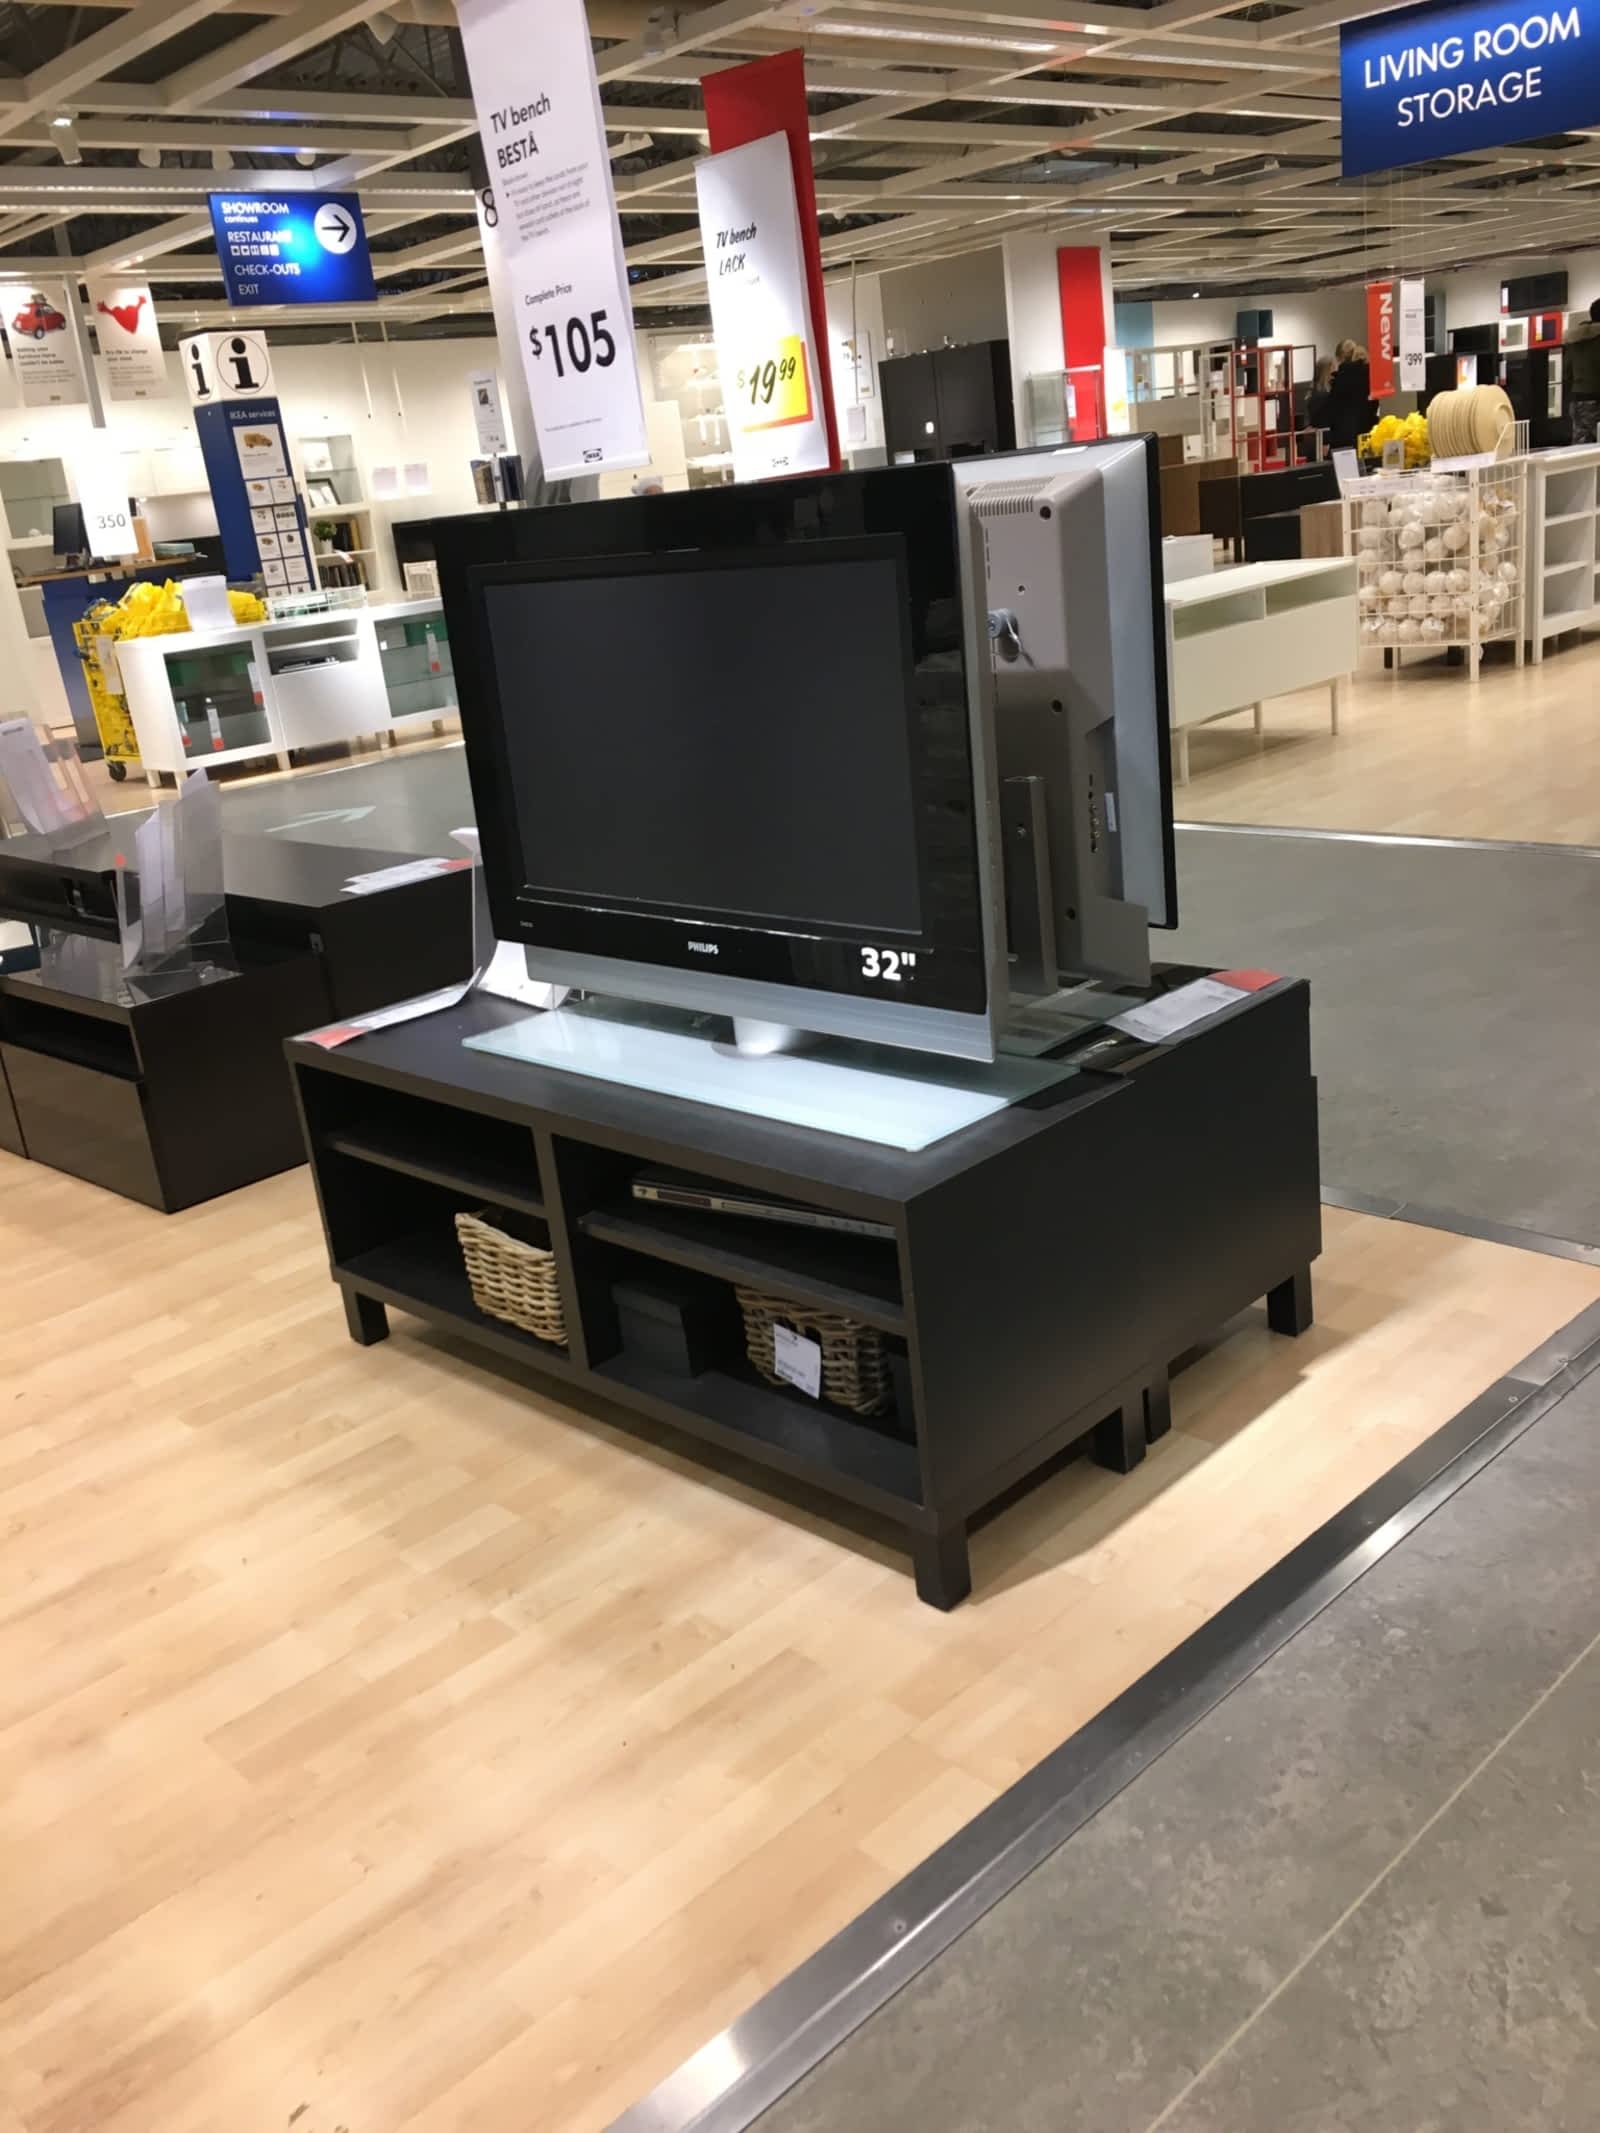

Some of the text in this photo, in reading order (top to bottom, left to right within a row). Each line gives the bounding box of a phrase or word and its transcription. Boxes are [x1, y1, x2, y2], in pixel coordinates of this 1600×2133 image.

[1364, 7, 1581, 89] LIVING ROOM
[1397, 66, 1542, 127] STORAGE
[490, 92, 551, 133] TV bench
[221, 201, 290, 215] SHOWROOM
[227, 230, 293, 243] RESTAURA
[716, 222, 757, 249] TV bench
[234, 263, 301, 276] CHECK-OUTS
[719, 253, 746, 276] LACK
[238, 283, 260, 296] EXIT
[525, 283, 572, 306] Complete Price
[1380, 292, 1393, 360] New
[529, 309, 616, 378] $105
[229, 409, 276, 420] IKEA services
[97, 513, 126, 529] 350
[688, 941, 719, 954] PHILIPS
